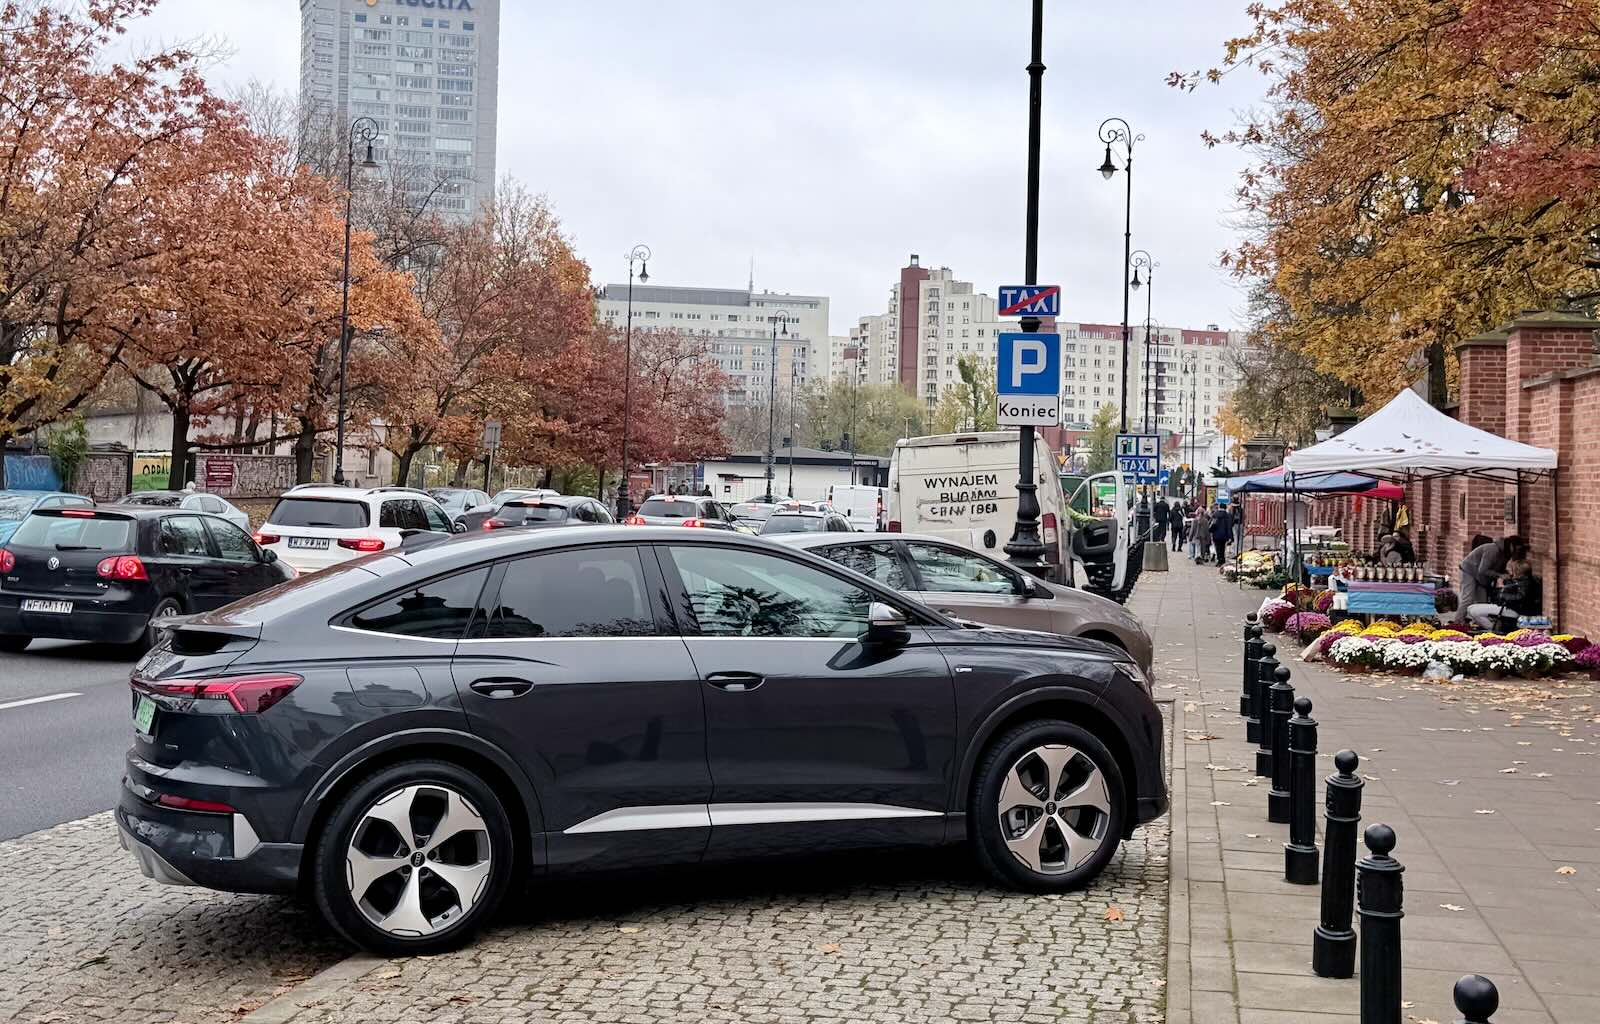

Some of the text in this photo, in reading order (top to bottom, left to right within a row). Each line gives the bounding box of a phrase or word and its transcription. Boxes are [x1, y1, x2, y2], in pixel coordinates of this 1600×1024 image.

[1001, 289, 1058, 313] TAXI
[1011, 340, 1047, 387] P
[998, 402, 1057, 418] Koniec
[1122, 459, 1150, 472] TAXI
[924, 474, 998, 488] WYNAJEM
